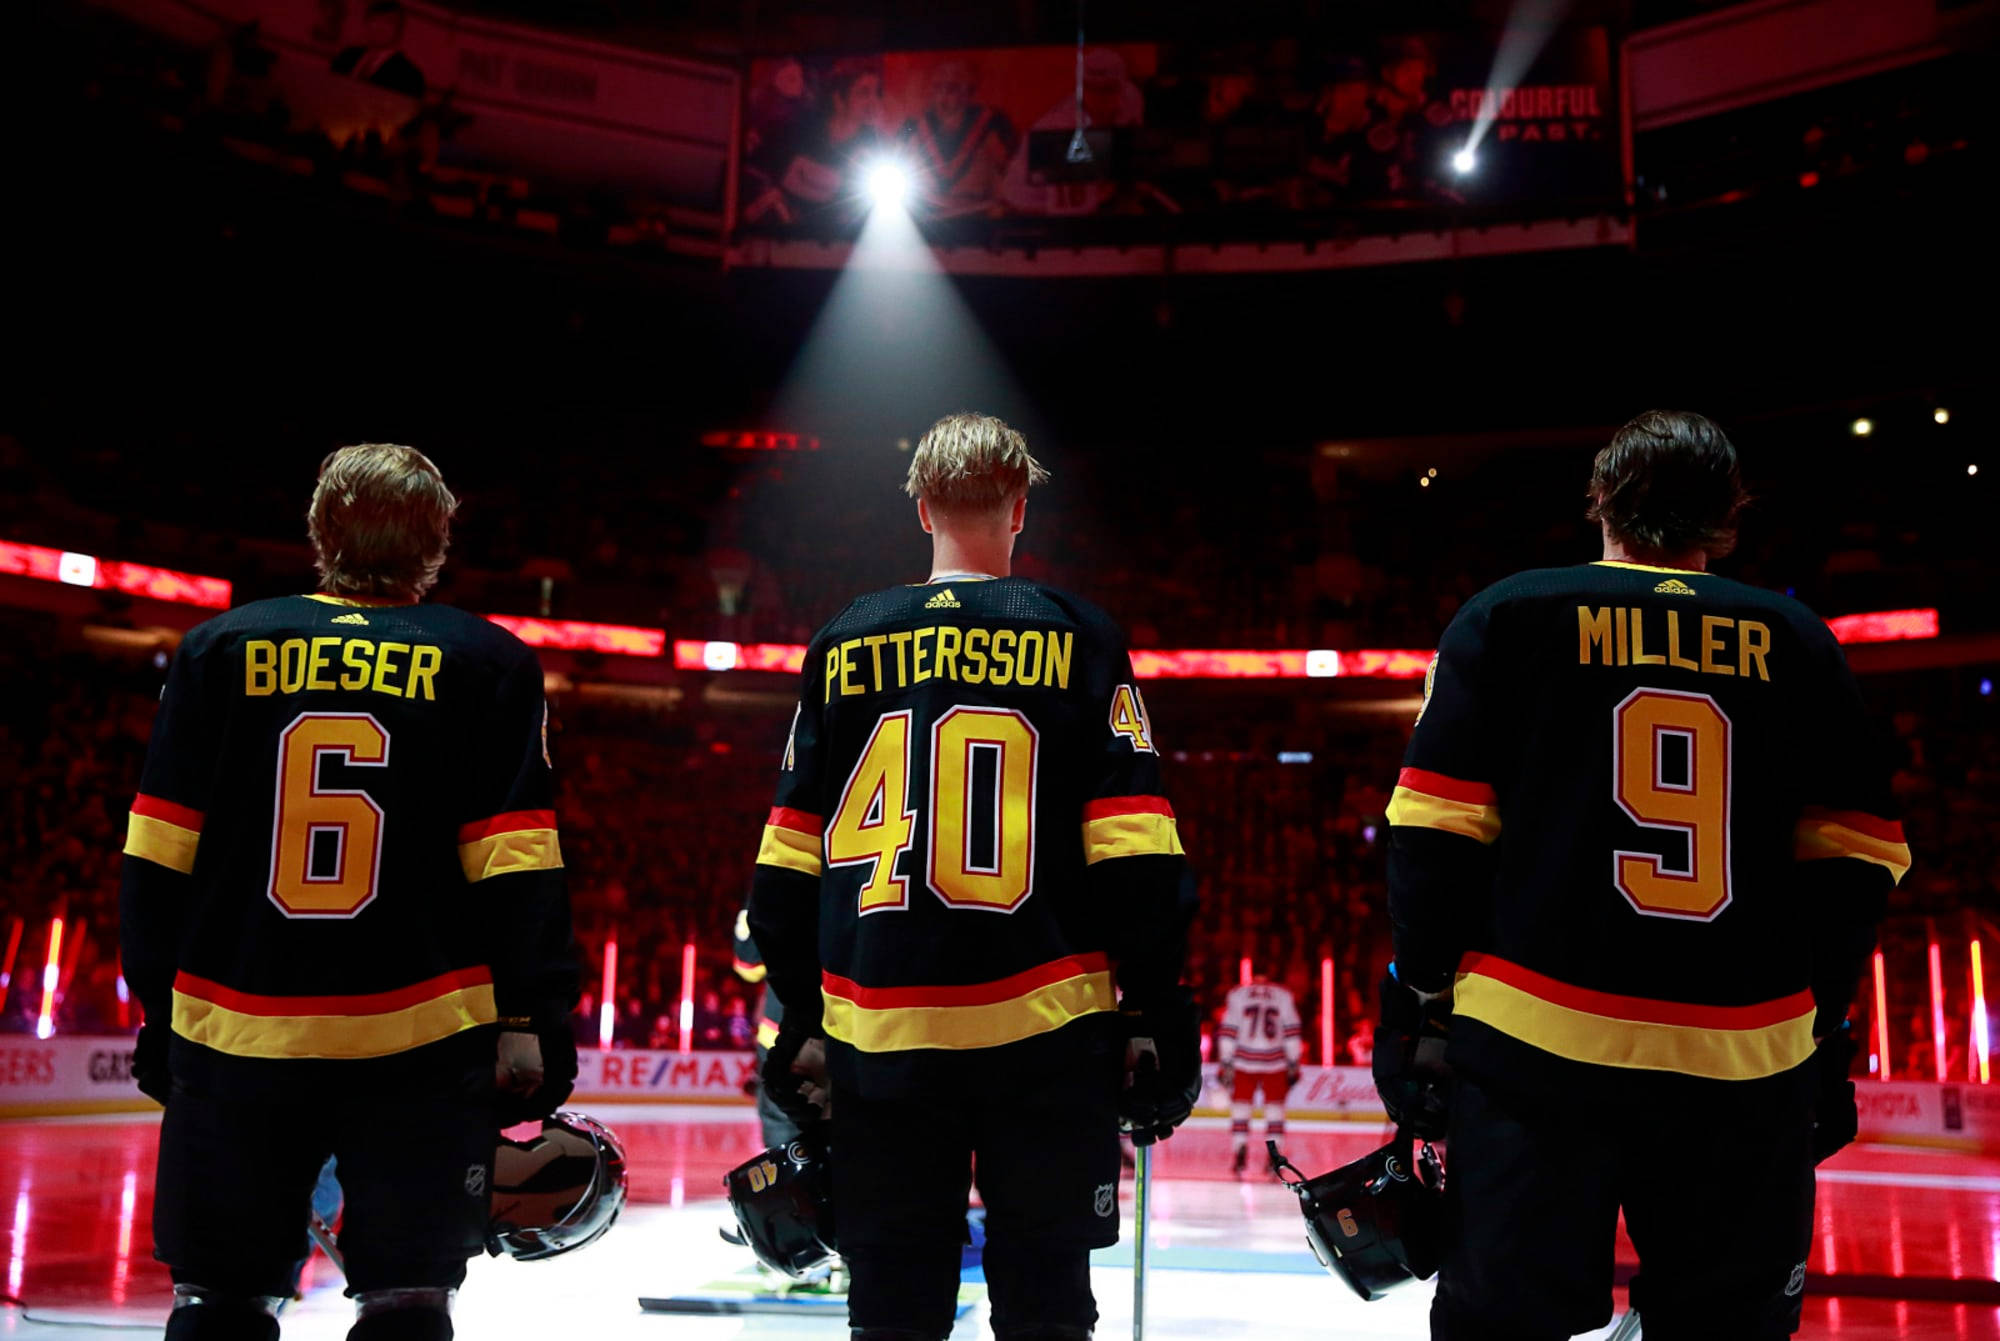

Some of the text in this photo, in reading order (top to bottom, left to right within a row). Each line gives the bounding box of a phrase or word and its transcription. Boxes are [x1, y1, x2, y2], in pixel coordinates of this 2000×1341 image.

[245, 636, 443, 701] BOESER
[824, 625, 1074, 705] PETTERSSON
[1578, 605, 1771, 682] MILLER
[1109, 684, 1161, 757] 4
[266, 711, 391, 919] 6
[824, 703, 1040, 917] 40
[1612, 686, 1733, 922] 9
[1243, 1005, 1280, 1040] 76
[601, 1054, 757, 1088] RE/MAX
[1855, 1091, 1921, 1118] OYOTA
